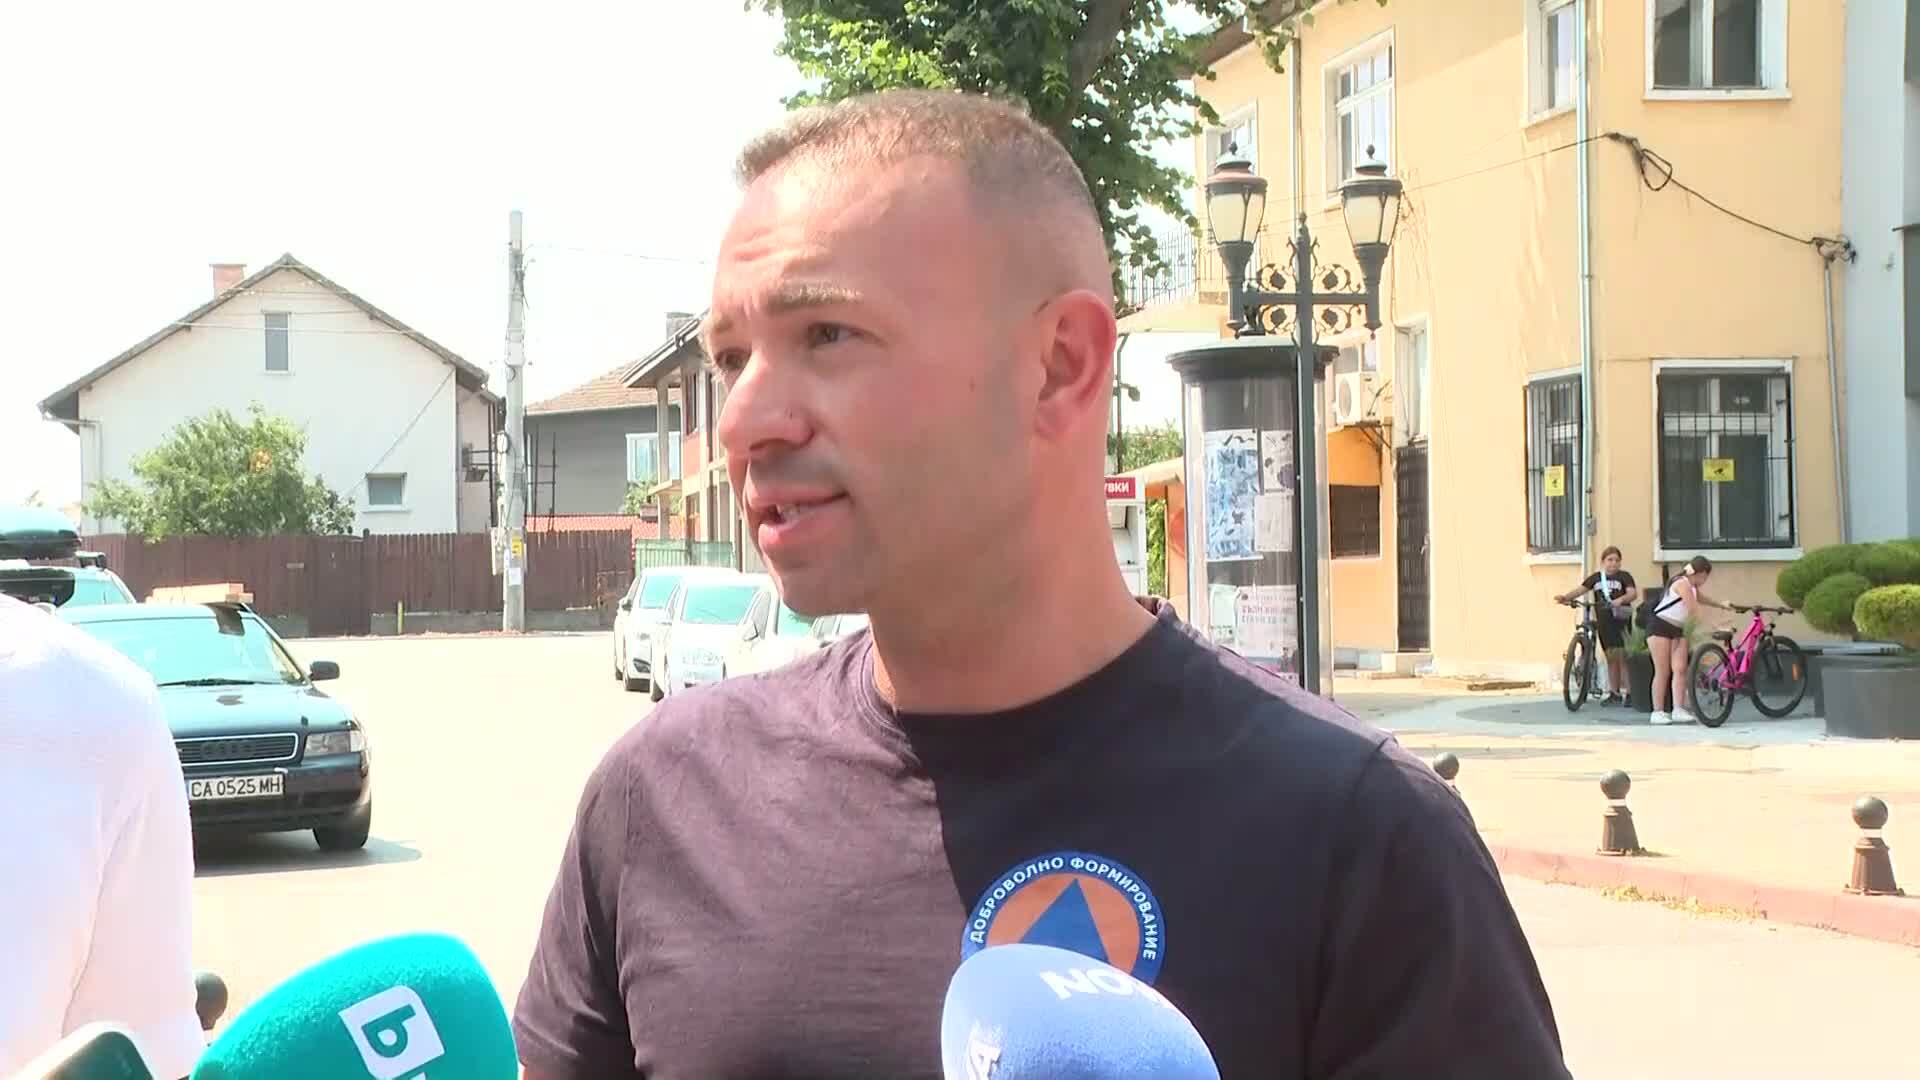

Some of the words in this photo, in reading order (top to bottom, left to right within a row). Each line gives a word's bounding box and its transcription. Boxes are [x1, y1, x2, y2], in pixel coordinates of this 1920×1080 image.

[191, 781, 212, 797] CA
[217, 779, 256, 796] 0525
[260, 776, 281, 793] MH
[969, 857, 1064, 944] ДОБРОВОЛНО
[1070, 857, 1159, 960] ФОРМИРОВАНИЕ
